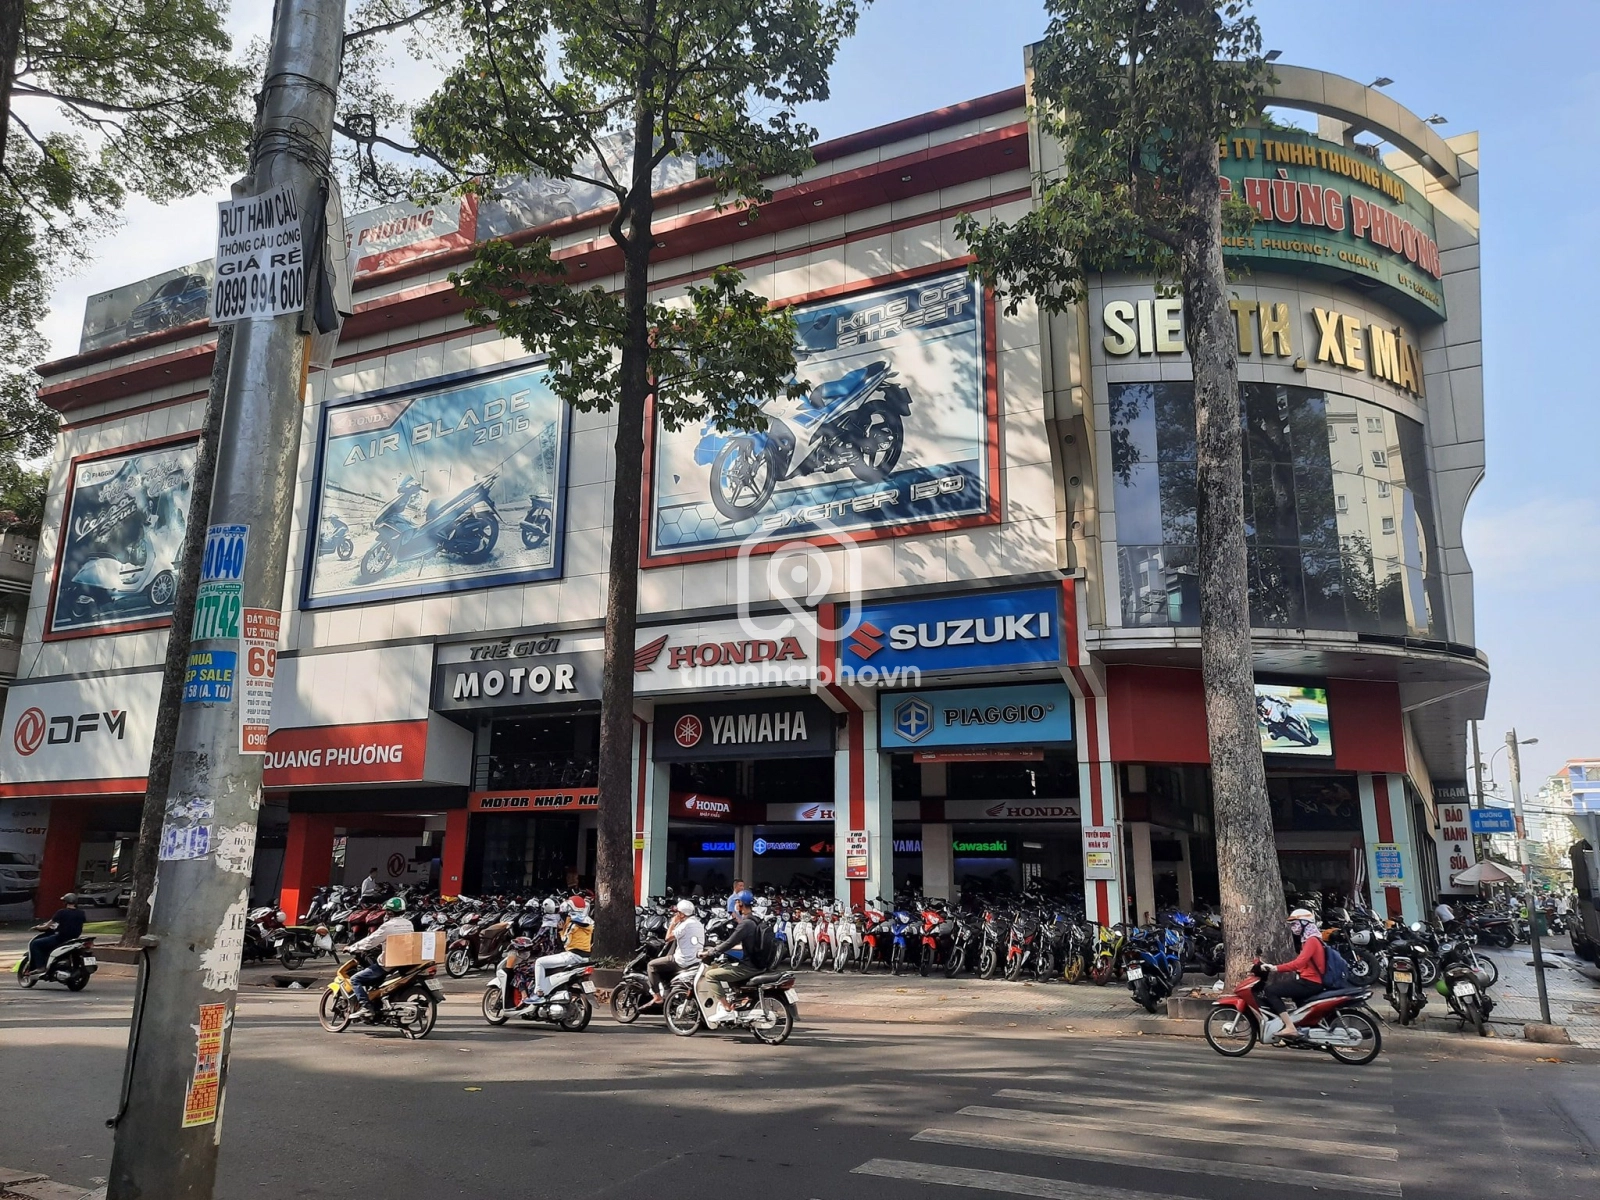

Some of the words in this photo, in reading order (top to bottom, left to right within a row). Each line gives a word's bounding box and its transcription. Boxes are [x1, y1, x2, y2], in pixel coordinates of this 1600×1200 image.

[1233, 138, 1256, 159] TY
[1262, 140, 1317, 166] TNHH
[1244, 168, 1345, 231] HÙNG
[220, 202, 245, 238] RÚT
[220, 240, 251, 257] THÔNG
[218, 254, 260, 276] GIÁ
[215, 276, 247, 319] 0899
[250, 272, 277, 312] 994
[280, 266, 303, 310] 600
[1312, 307, 1365, 371] XE
[343, 432, 400, 466] AIR
[411, 389, 531, 446] BLADE
[348, 412, 391, 428] HONDA
[472, 415, 530, 447] 2016
[889, 612, 1050, 650] SUZUKI
[190, 652, 212, 666] MUA
[248, 646, 276, 679] 69
[667, 636, 807, 670] HONDA
[200, 669, 232, 681] SALE
[453, 663, 576, 699] MOTOR
[47, 709, 127, 745] DFM
[709, 711, 807, 745] YAMAHA
[943, 704, 1047, 726] PIAGGIO
[264, 749, 321, 769] QUANG
[325, 744, 403, 766] PHƯƠNG
[481, 797, 530, 808] MOTOR
[533, 793, 574, 809] NHẬP
[696, 801, 730, 813] HONDA
[1007, 806, 1079, 817] HONDA
[25, 827, 47, 835] CM7
[952, 840, 1007, 851] Kawasaki
[1454, 844, 1461, 853] &
